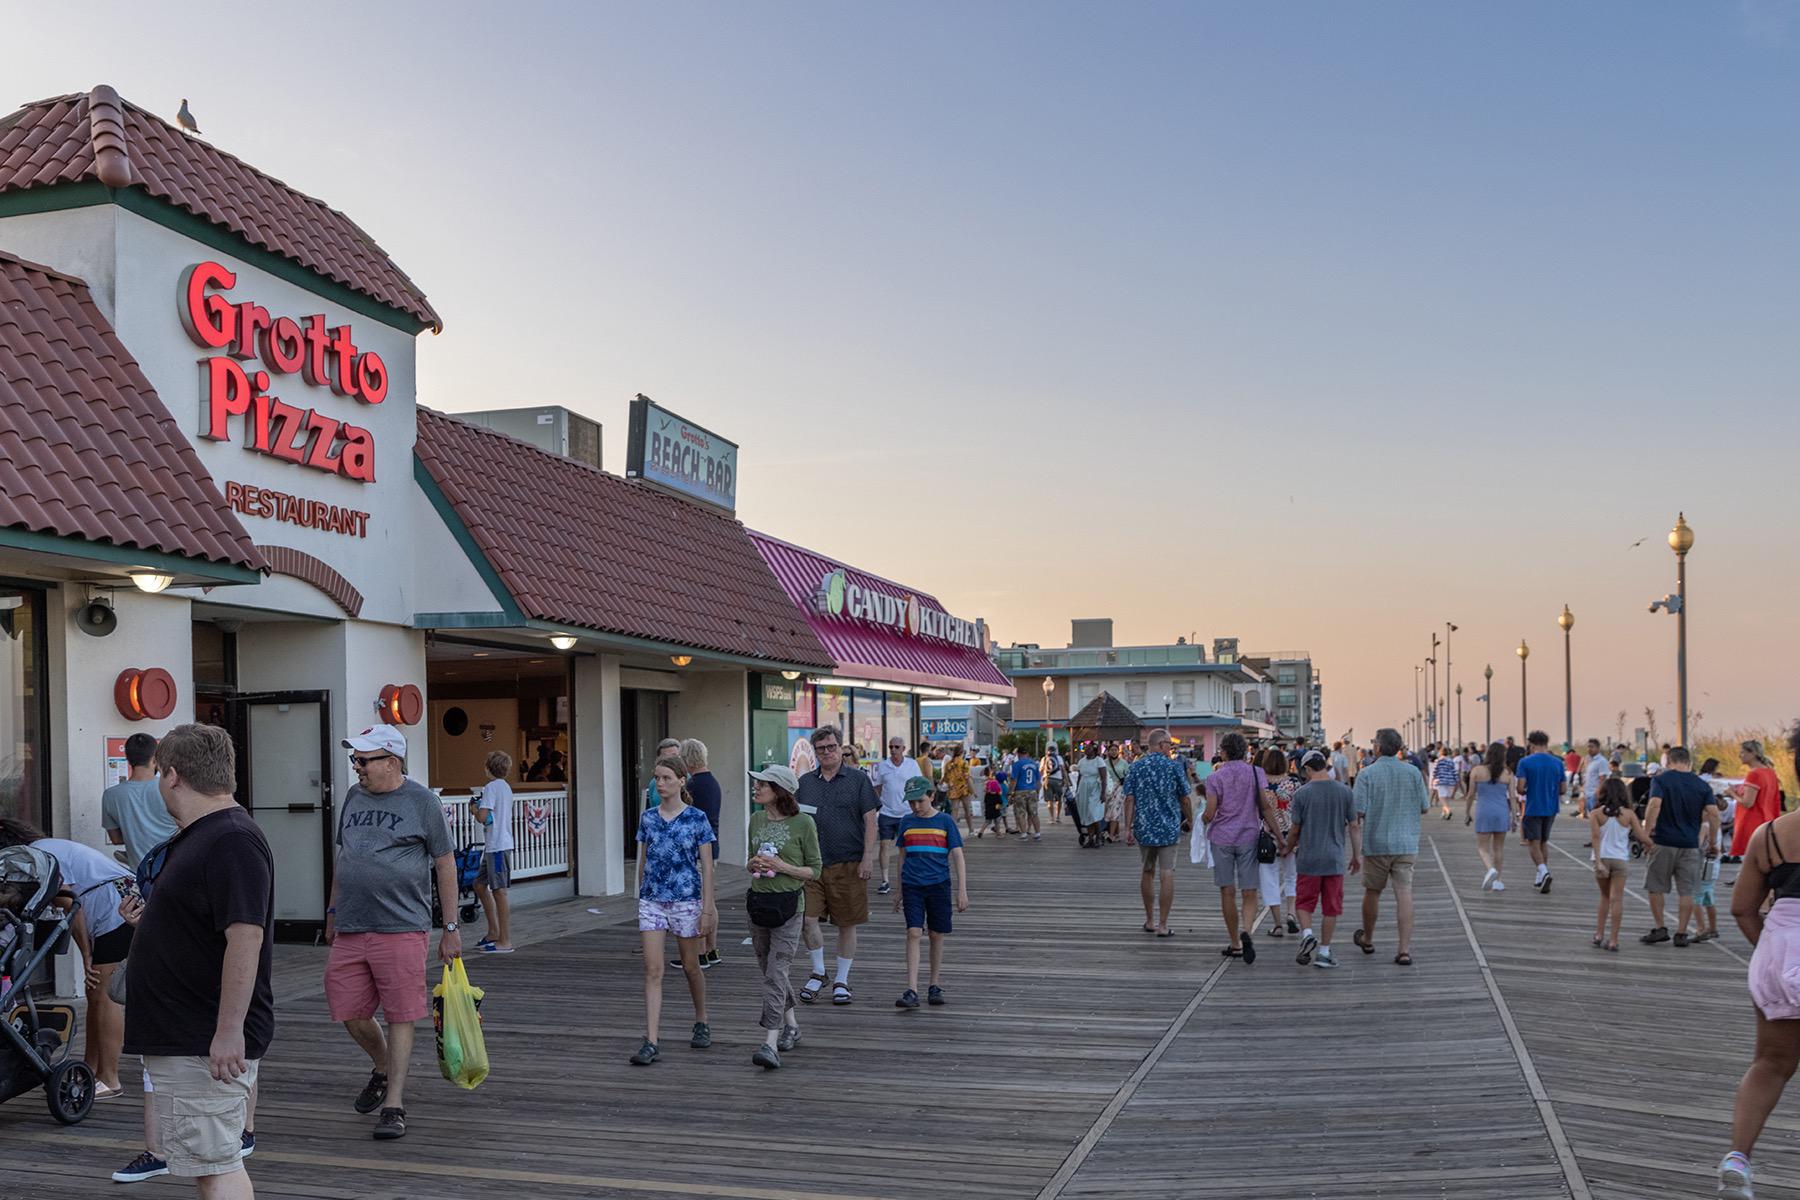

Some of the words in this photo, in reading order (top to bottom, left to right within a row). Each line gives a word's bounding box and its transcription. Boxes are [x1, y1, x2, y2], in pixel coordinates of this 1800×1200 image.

[179, 261, 389, 405] Grotto
[198, 356, 376, 483] Pizza
[680, 424, 710, 450] Grotto's
[652, 431, 701, 482] BEACH
[706, 455, 732, 494] BAR
[226, 480, 370, 538] RESTAURANT
[846, 583, 908, 629] CANDY
[919, 606, 981, 649] KITCHEN
[937, 720, 967, 734] BROS
[345, 809, 404, 831] NAVY
